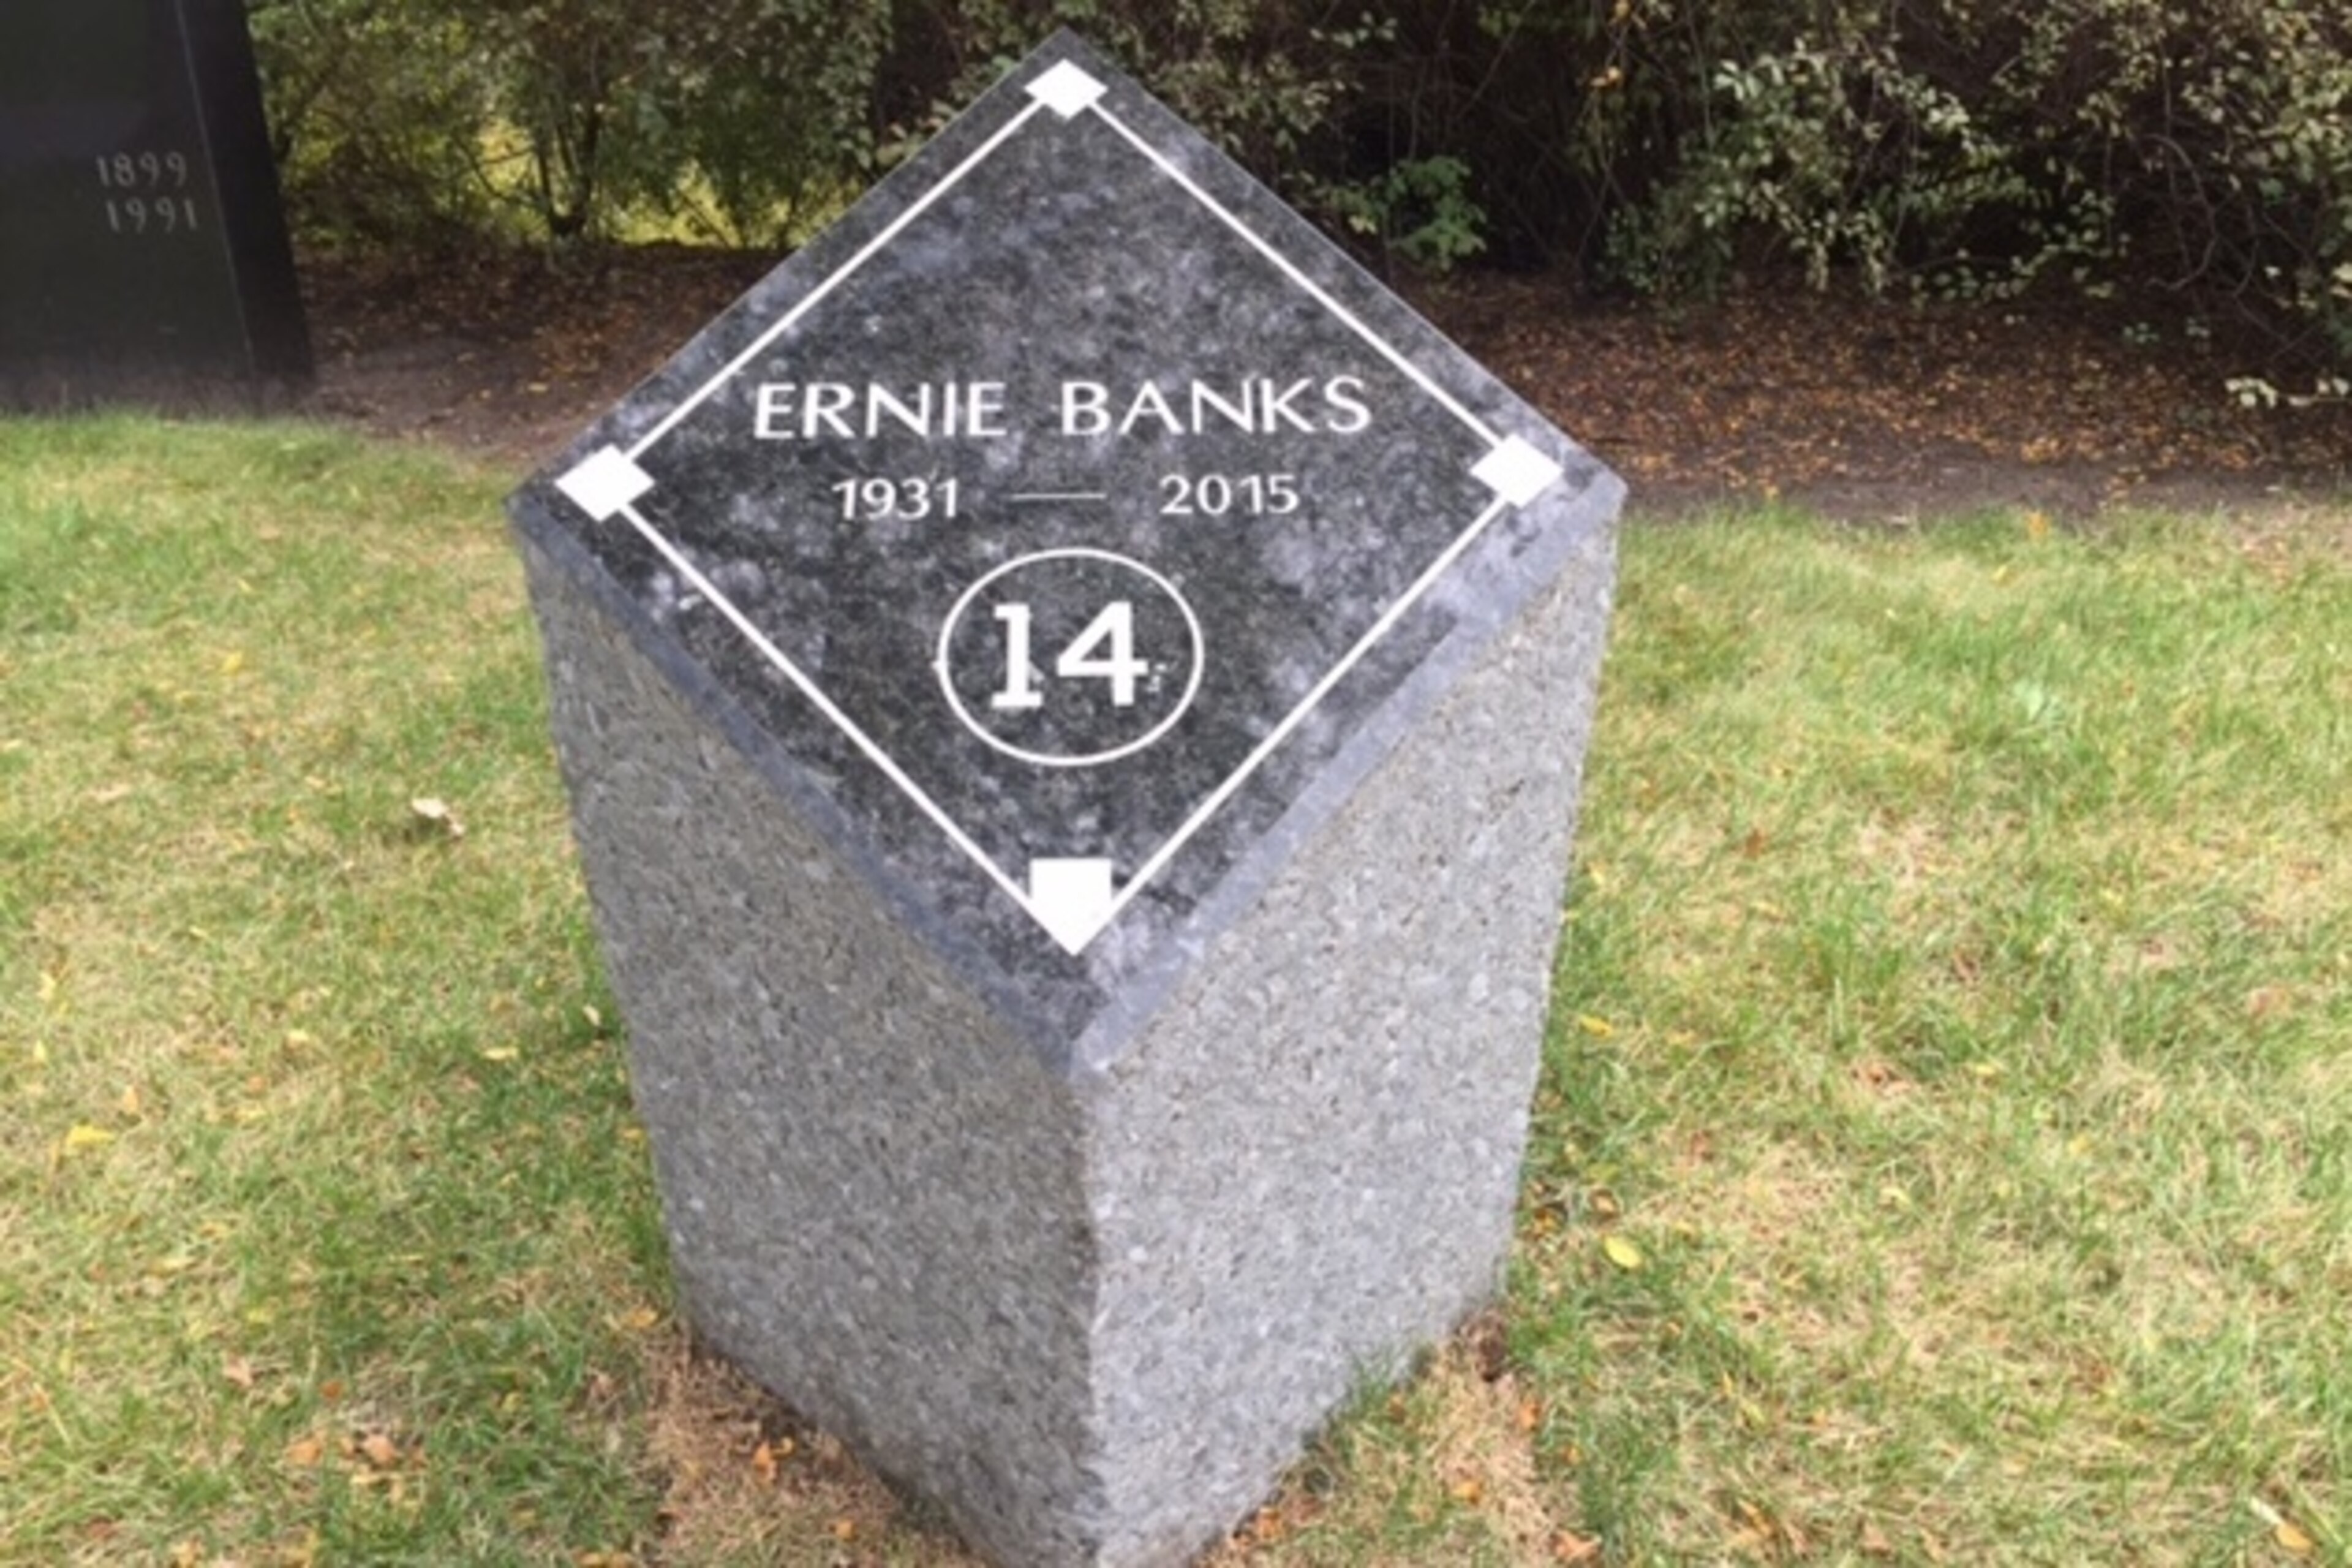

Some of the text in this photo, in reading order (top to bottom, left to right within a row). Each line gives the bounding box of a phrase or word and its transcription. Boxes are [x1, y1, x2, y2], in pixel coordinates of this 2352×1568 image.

[96, 151, 187, 187] 1899
[105, 196, 197, 233] 1991
[753, 375, 1373, 439] ERNIE BANKS
[832, 473, 1300, 521] 1931 2015
[990, 601, 1149, 709] 14
